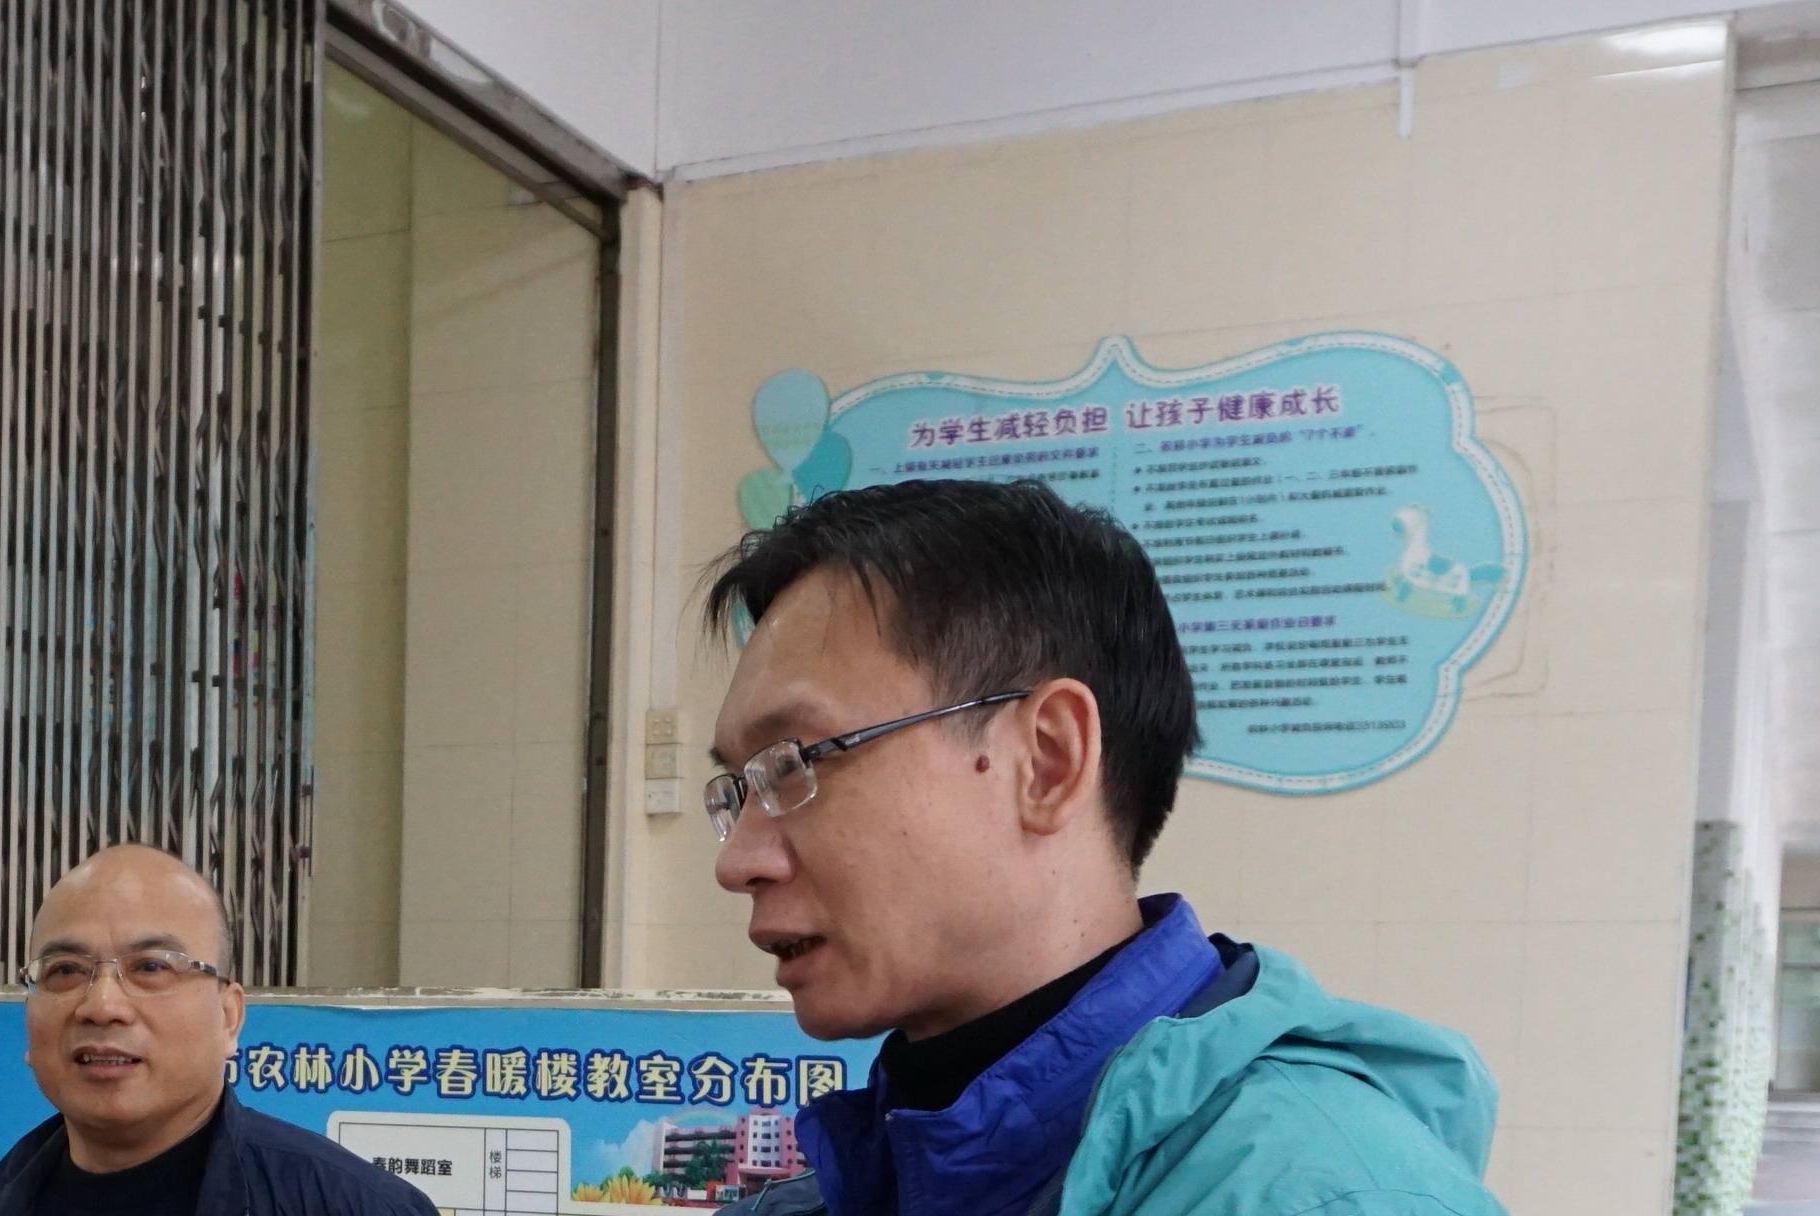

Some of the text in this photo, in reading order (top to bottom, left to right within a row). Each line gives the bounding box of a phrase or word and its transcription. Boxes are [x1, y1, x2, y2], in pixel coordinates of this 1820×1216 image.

[910, 386, 1340, 448] 为学生减轻负担 让孩子健康成长
[373, 1156, 453, 1176] 春韵舞蹈室
[488, 1149, 502, 1179] 楼梯
